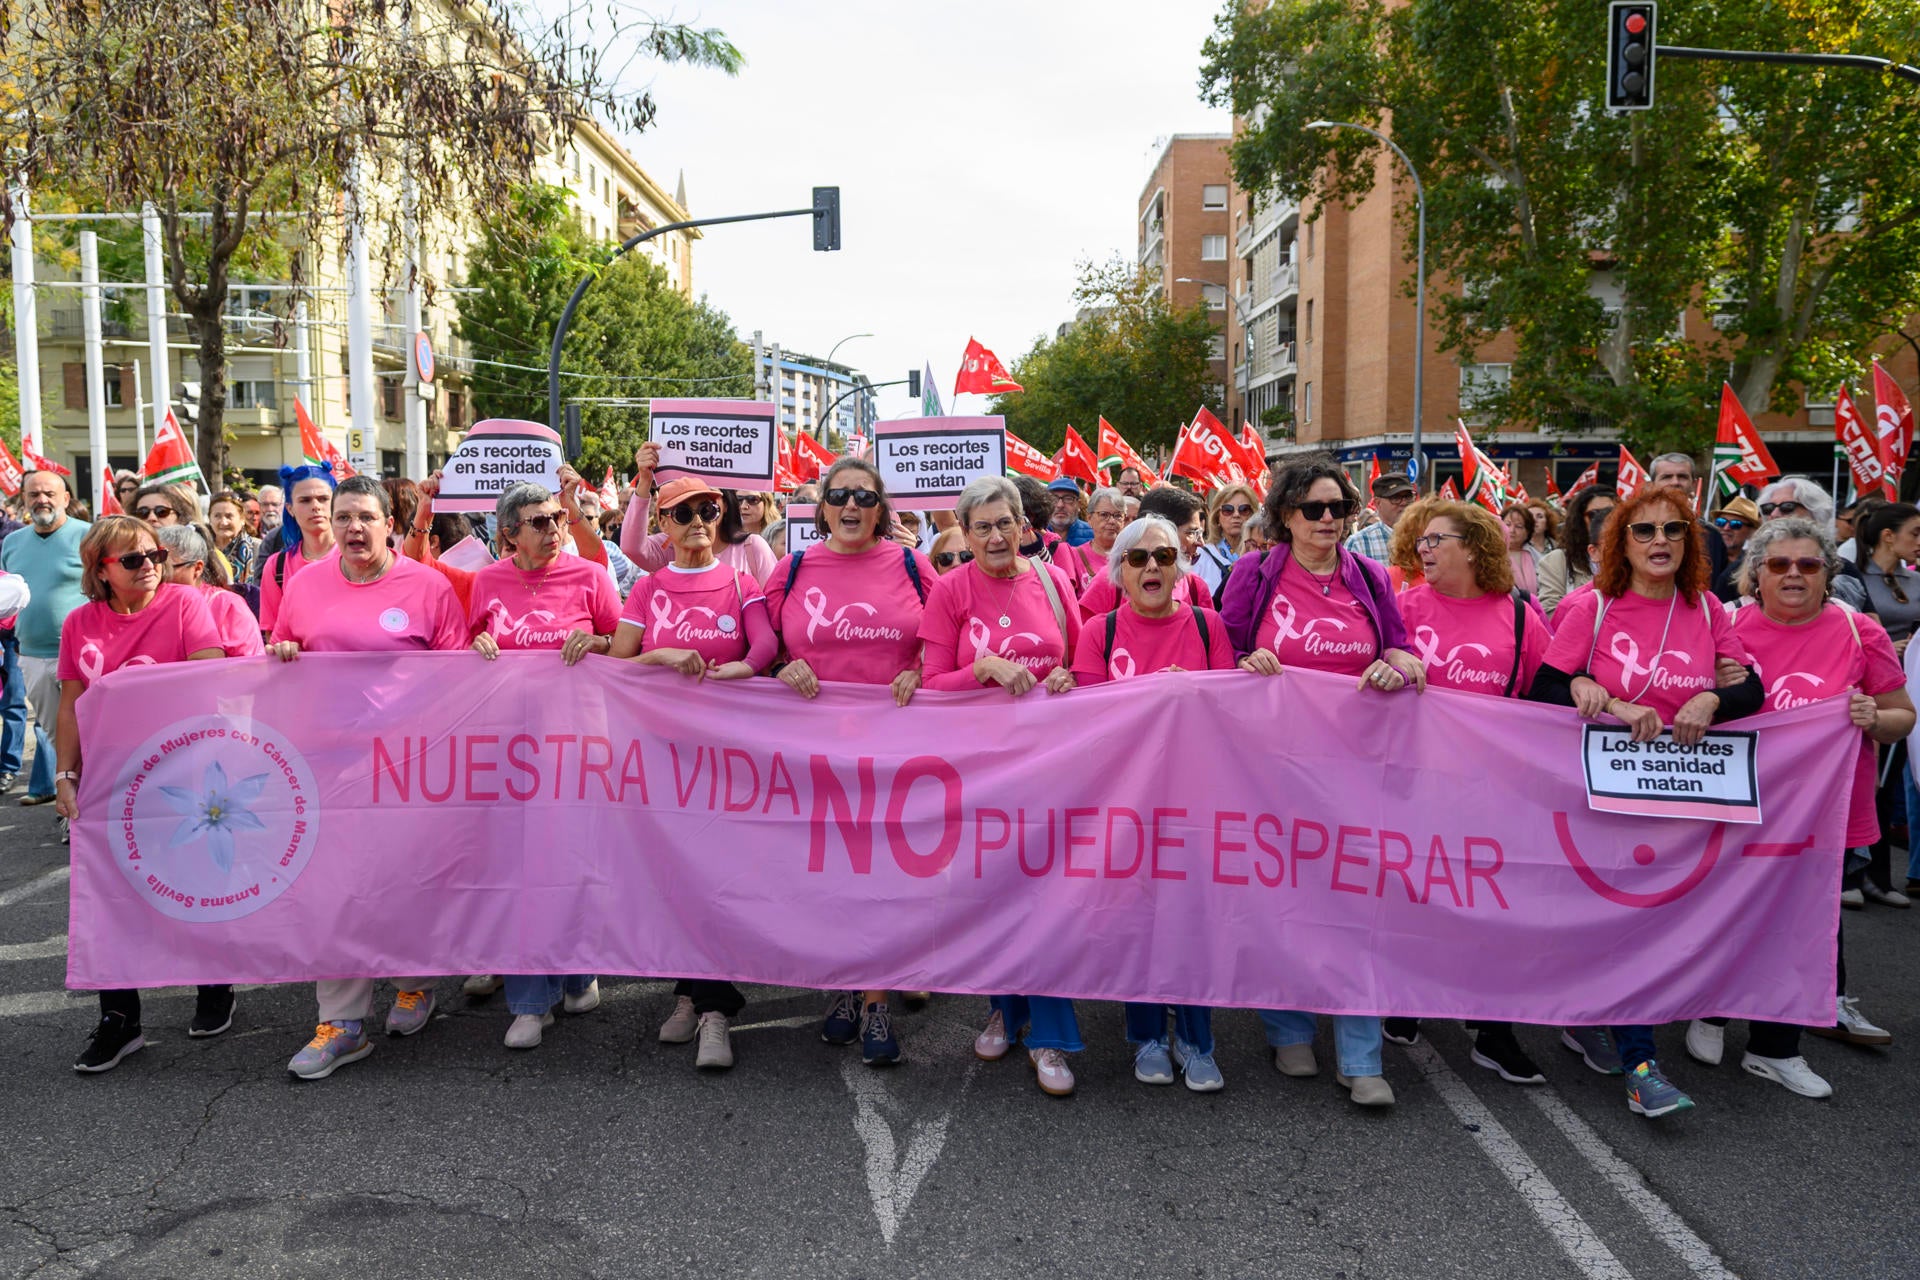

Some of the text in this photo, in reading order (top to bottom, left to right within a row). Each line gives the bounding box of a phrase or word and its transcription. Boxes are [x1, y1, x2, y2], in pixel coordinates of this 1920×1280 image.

[661, 421, 759, 439] Los recortes
[352, 433, 361, 448] 5
[667, 439, 752, 454] en sanidad
[889, 440, 990, 457] Los recortes
[1189, 421, 1233, 464] UGT
[484, 444, 552, 458] recortes
[455, 460, 545, 474] en sanidad
[685, 455, 733, 469] matan
[895, 455, 984, 473] en sanidad
[915, 473, 966, 489] matan
[515, 625, 574, 647] Amam
[835, 618, 904, 641] Amama
[1304, 631, 1374, 656] Amama
[1602, 736, 1734, 756] Los recortes
[1610, 757, 1726, 775] en sanidad
[1637, 776, 1703, 792] matan
[121, 727, 307, 867] Asociación de Mujeres con Cáncer de Mama
[372, 734, 1509, 909] NUESTRA VIDA NO PUEDE ESPERAR
[146, 874, 260, 908] Amama Sevilla
